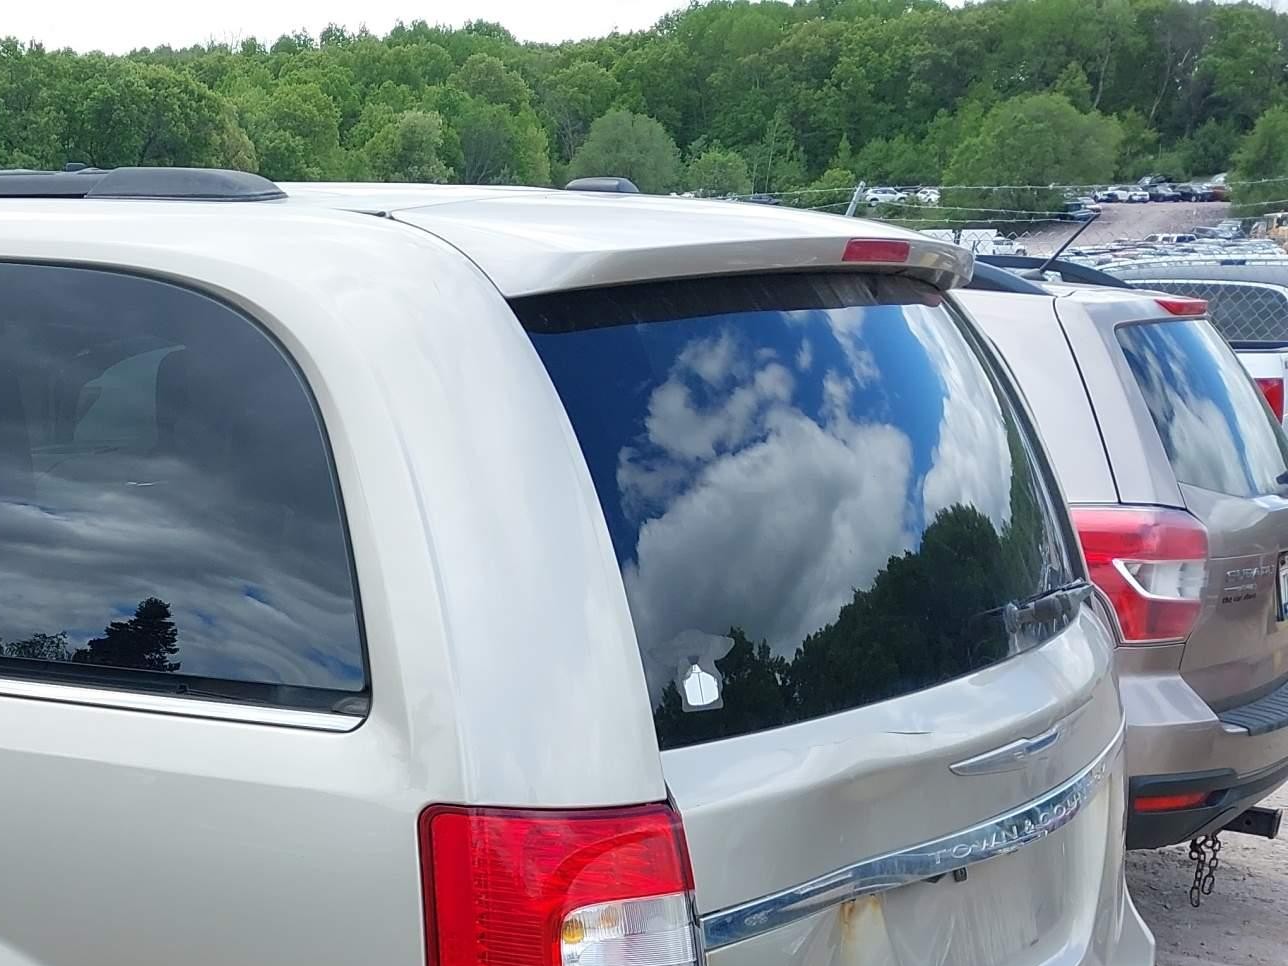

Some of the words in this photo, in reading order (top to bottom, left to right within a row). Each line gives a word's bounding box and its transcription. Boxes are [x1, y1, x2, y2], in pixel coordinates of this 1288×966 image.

[927, 825, 1018, 864] TOWN
[1024, 819, 1036, 834] &
[1039, 763, 1106, 825] COUNY
